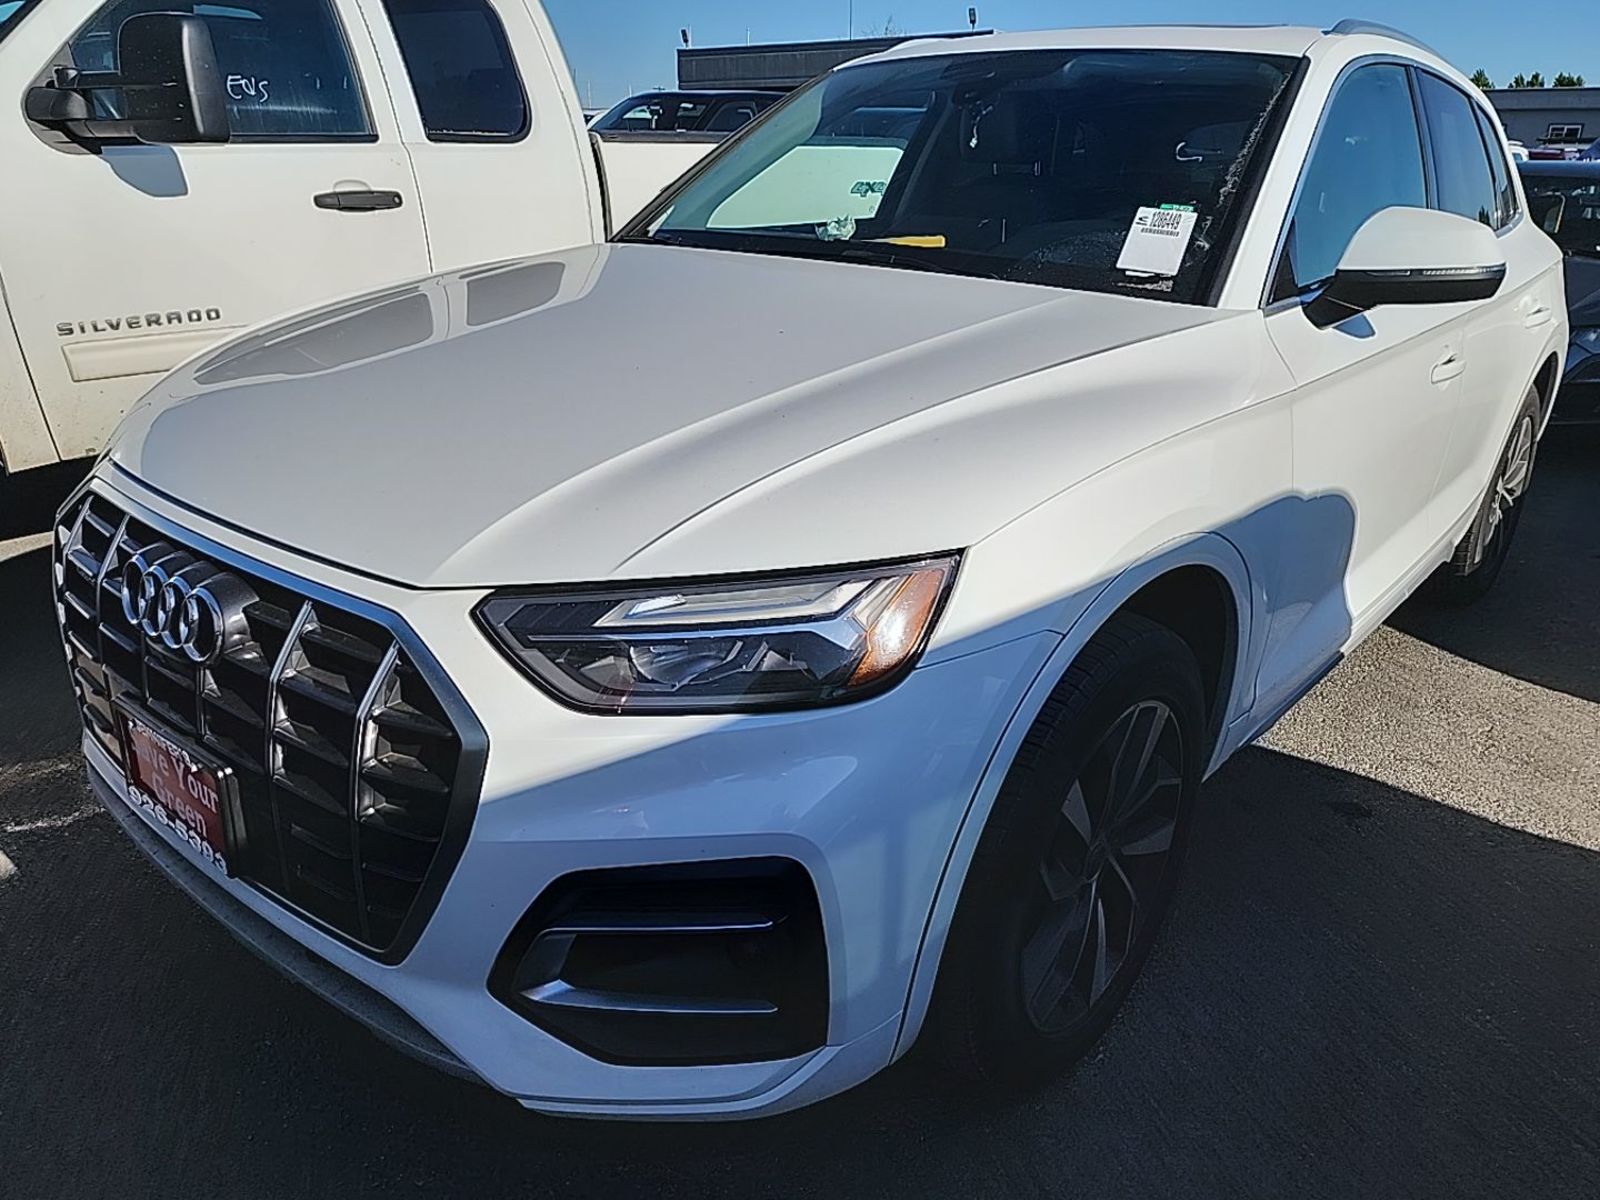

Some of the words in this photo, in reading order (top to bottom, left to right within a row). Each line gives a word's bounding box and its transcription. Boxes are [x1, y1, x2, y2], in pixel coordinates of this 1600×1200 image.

[56, 307, 222, 337] SILVERADO
[151, 771, 209, 838] Green
[170, 755, 220, 814] Your
